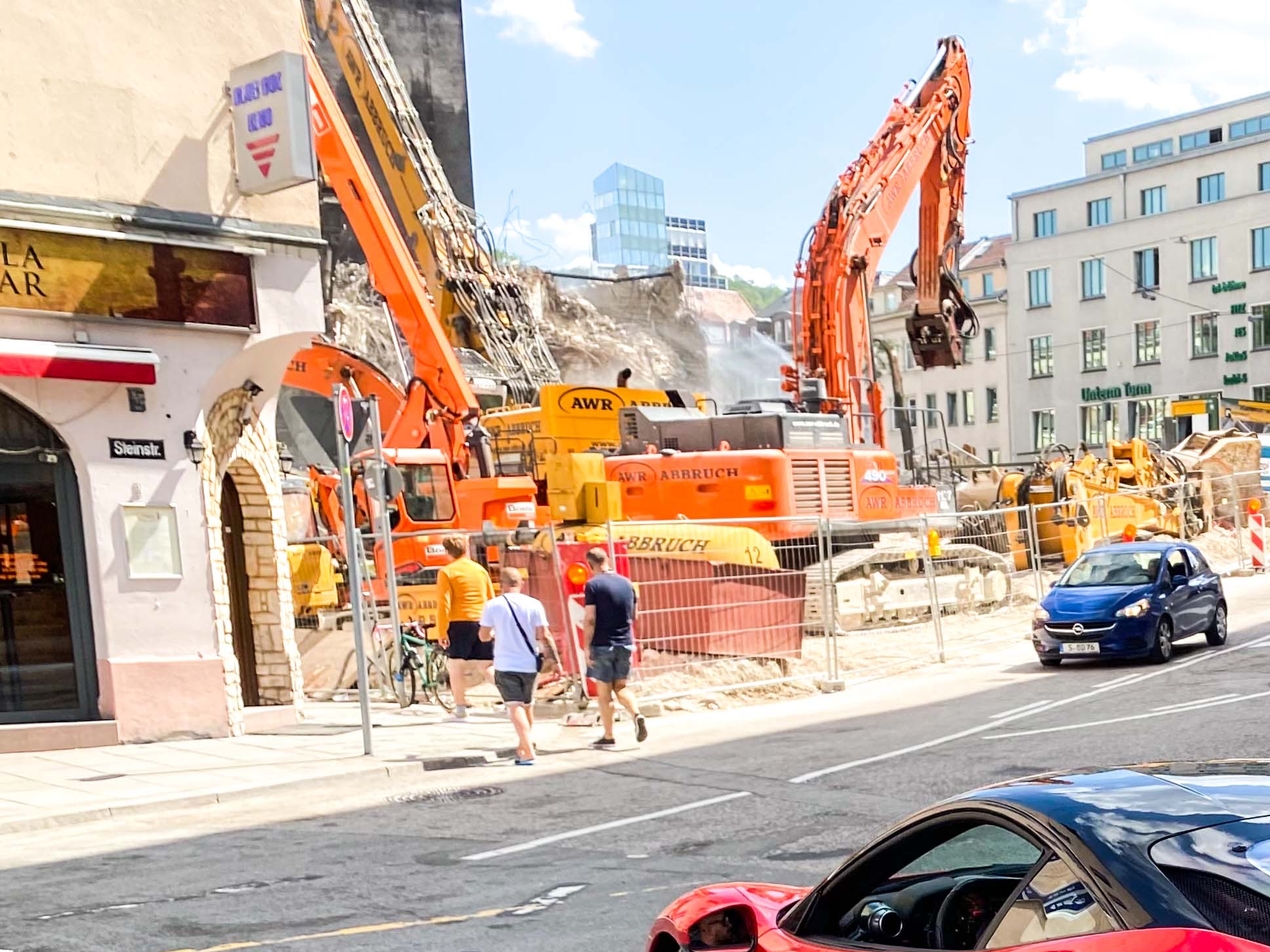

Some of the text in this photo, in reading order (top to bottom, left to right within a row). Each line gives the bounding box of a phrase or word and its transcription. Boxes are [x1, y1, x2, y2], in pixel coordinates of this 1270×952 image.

[570, 396, 614, 412] AWR
[113, 439, 162, 457] Steinstr.
[618, 468, 739, 483] AWR ABBRUCH
[864, 470, 888, 482] 490
[619, 535, 711, 553] BBRUCH
[744, 545, 764, 565] 12
